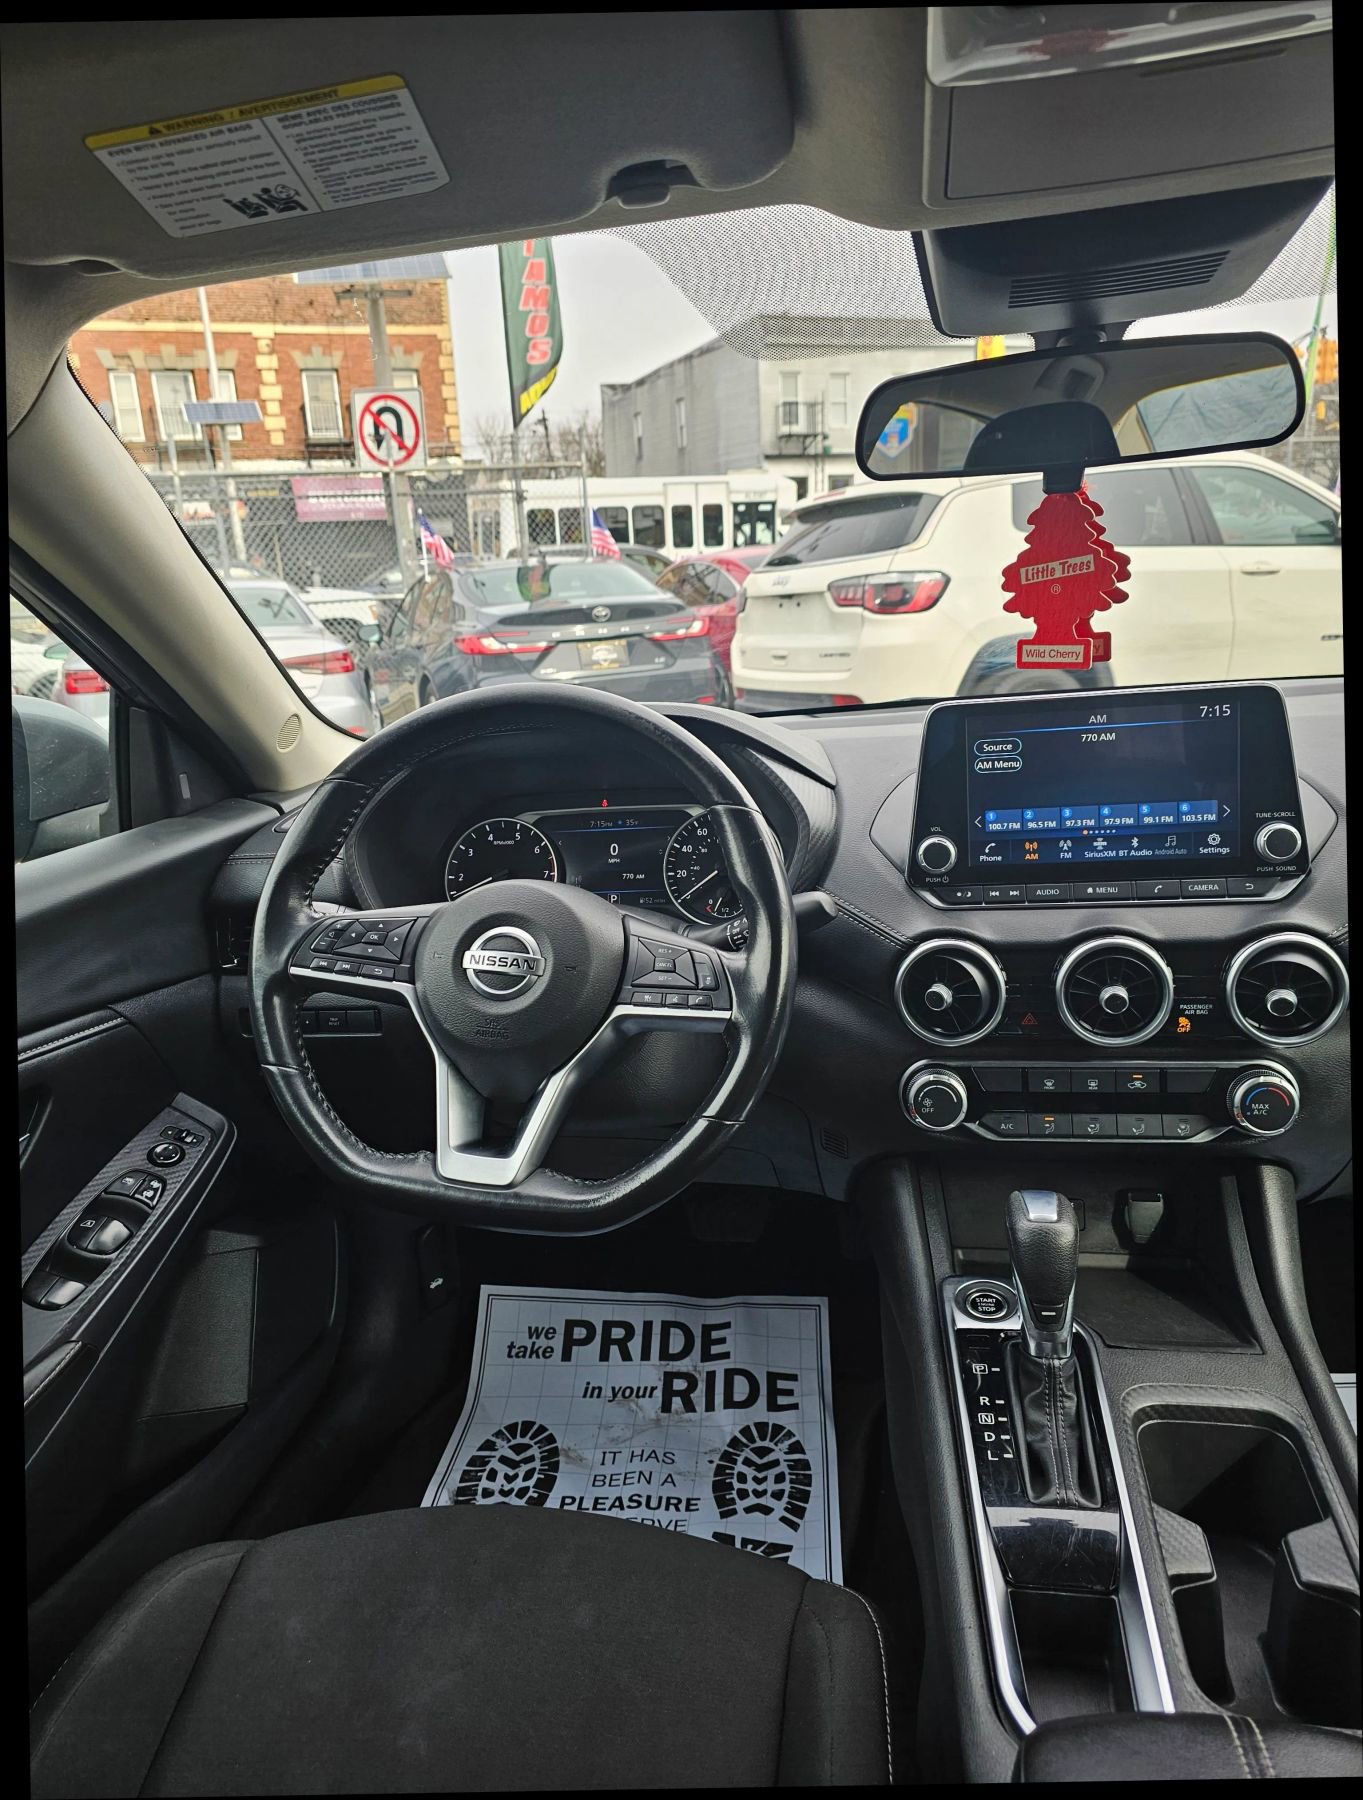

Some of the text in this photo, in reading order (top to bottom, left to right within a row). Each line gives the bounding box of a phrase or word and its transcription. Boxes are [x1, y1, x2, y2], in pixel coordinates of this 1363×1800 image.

[1024, 559, 1091, 582] Little Trees
[1025, 648, 1081, 661] Wild Cherry
[1199, 704, 1231, 718] 7:15
[1089, 715, 1107, 724] AM
[1081, 732, 1116, 742] 770 AM
[983, 743, 1013, 752] Source
[976, 759, 1020, 769] AM Menu
[1104, 818, 1120, 826] 97.9
[1143, 816, 1160, 824] 99.1
[515, 832, 522, 841] 5
[697, 828, 708, 836] 60
[487, 833, 494, 842] 4
[468, 848, 474, 857] 3
[534, 845, 540, 854] 6
[610, 843, 619, 856] 0
[681, 845, 693, 853] 40
[1130, 848, 1152, 857] Audio
[1199, 846, 1230, 854] Settings
[979, 854, 1002, 863] Phone
[1084, 850, 1116, 858] SiriusXM
[458, 873, 464, 881] 2
[543, 870, 549, 879] 7
[676, 870, 687, 878] 20
[1036, 888, 1060, 896] AUDIO
[1188, 884, 1219, 892] CAMERA
[469, 954, 537, 972] NISSAN
[527, 1324, 557, 1340] we
[506, 1319, 732, 1363] take PRIDE
[582, 1368, 800, 1414] in your RIDE
[980, 1396, 991, 1406] R
[981, 1414, 992, 1423] N
[984, 1431, 996, 1442] D
[600, 1449, 676, 1466] IT HAS
[987, 1449, 999, 1461] L
[591, 1470, 677, 1489] BEEN A
[559, 1493, 701, 1512] PLEASURE
